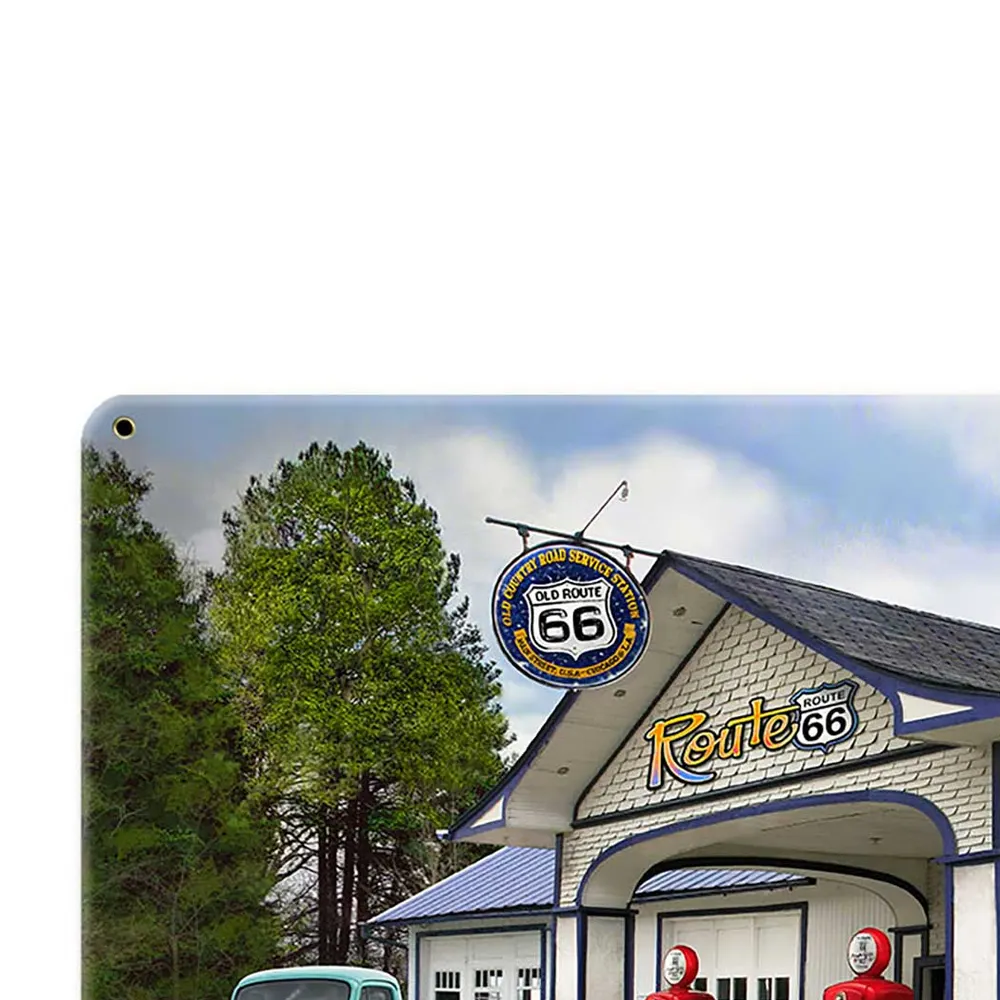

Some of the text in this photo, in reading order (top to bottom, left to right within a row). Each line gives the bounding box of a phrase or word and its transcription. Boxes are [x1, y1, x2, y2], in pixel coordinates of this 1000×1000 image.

[501, 547, 641, 627] OLD COUNTRY ROAD SERVICE STATION
[535, 585, 603, 602] OLD ROUTE
[538, 605, 606, 644] 66
[802, 688, 846, 709] ROUTE
[802, 706, 847, 742] 66
[645, 696, 800, 790] Route
